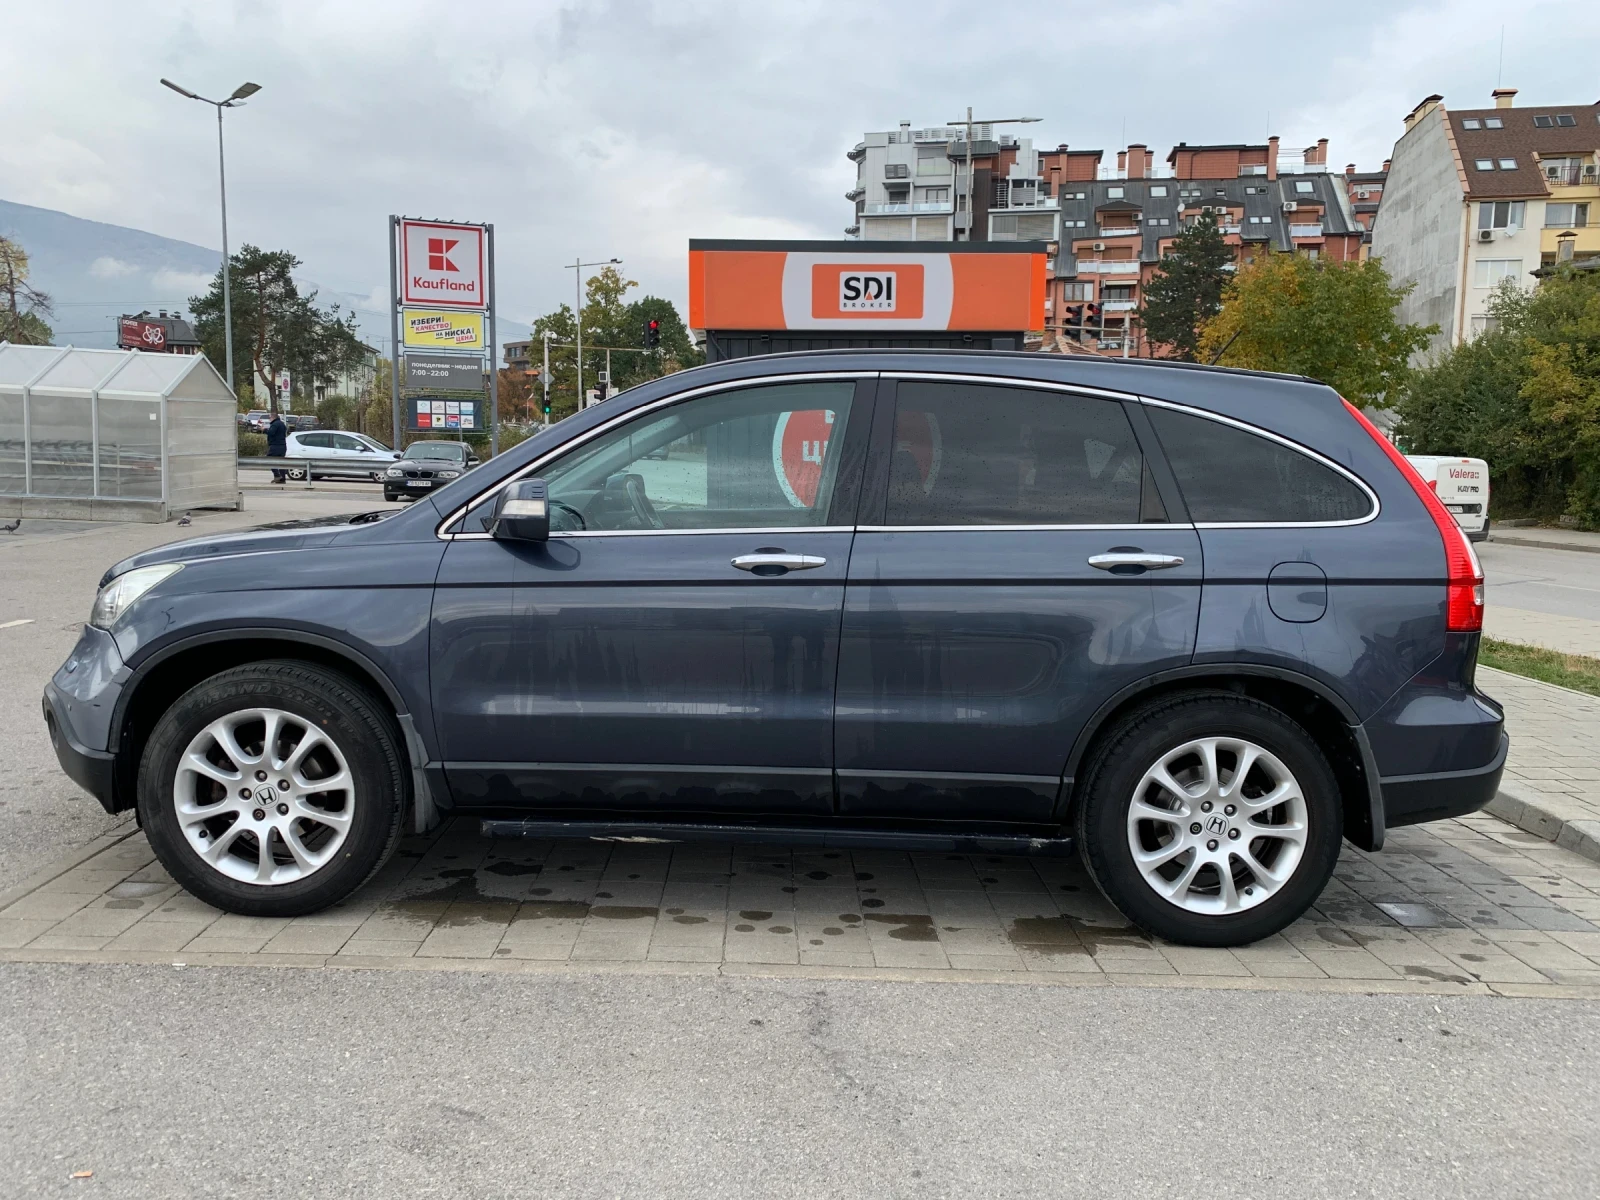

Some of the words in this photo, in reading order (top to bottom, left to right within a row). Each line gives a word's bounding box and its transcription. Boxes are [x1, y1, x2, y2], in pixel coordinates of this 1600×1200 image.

[413, 276, 475, 292] Kaufland
[843, 276, 892, 301] SDI
[410, 316, 442, 326] ИЗБЕРИ
[416, 322, 450, 332] КАЧЕСТВО
[444, 328, 472, 338] НИСКА
[1449, 468, 1475, 479] Valera
